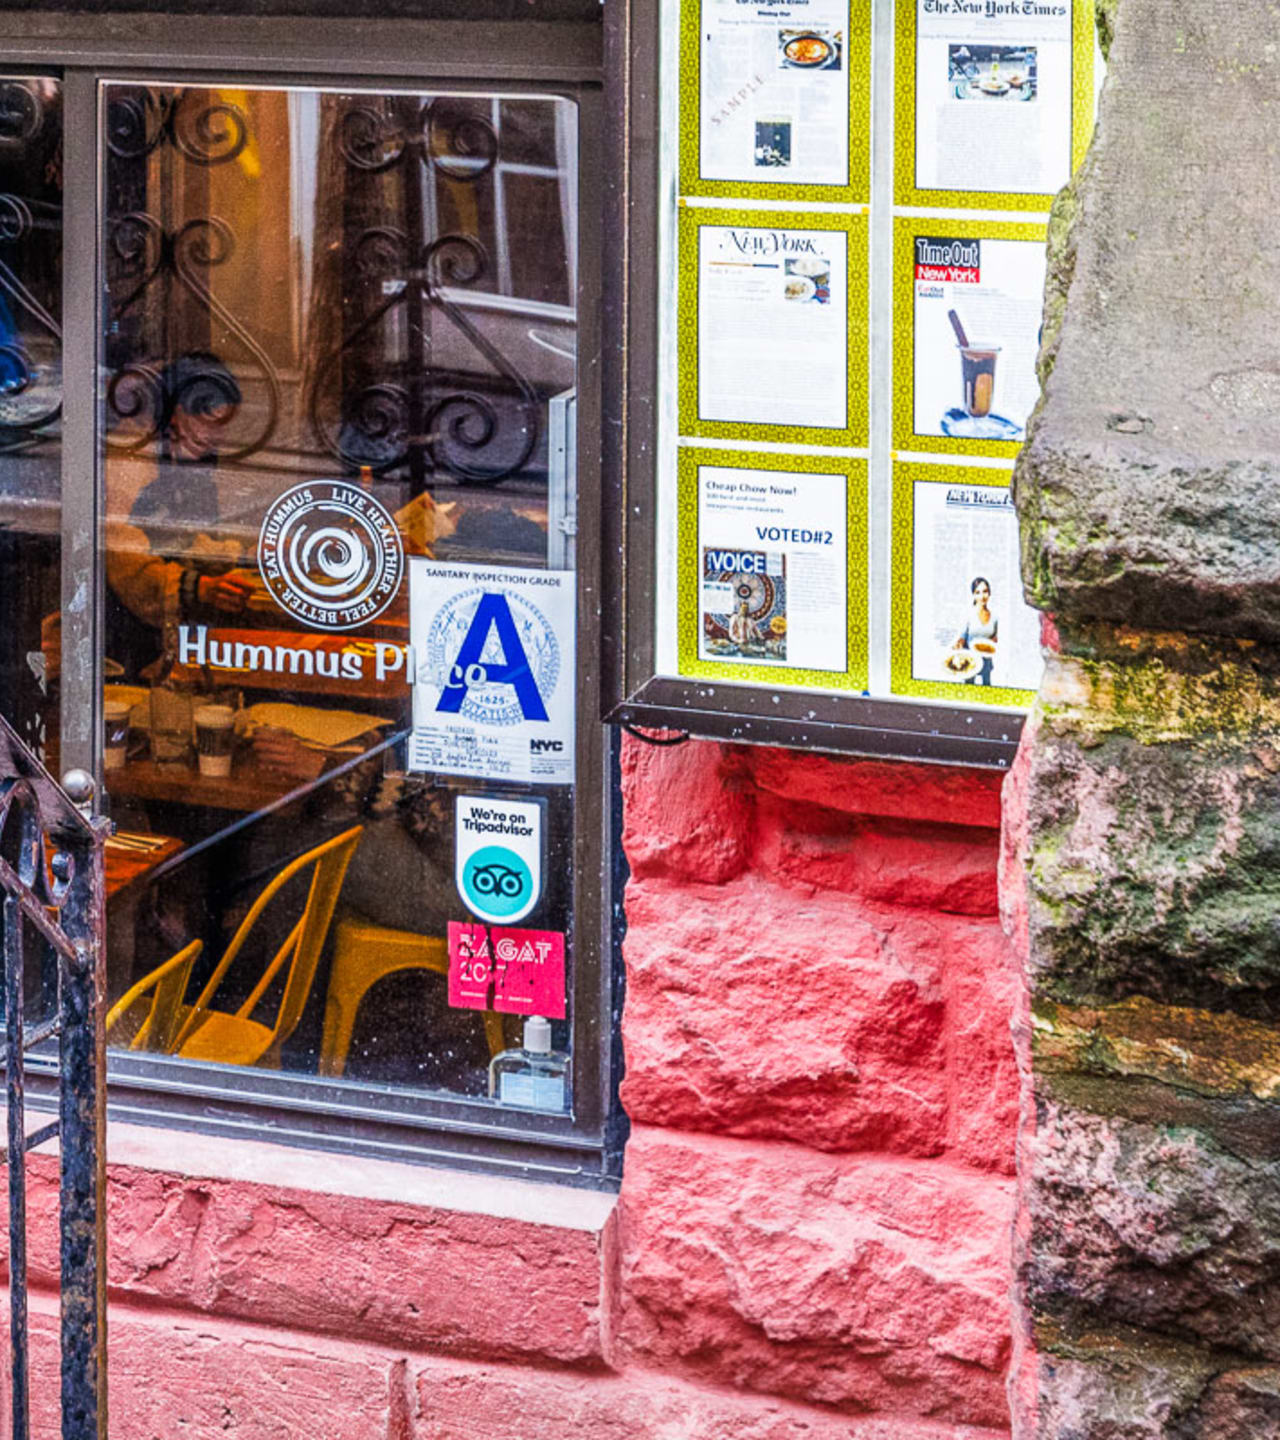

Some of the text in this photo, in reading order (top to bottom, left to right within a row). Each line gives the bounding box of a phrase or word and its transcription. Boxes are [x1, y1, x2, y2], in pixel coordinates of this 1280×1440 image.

[951, 0, 983, 13] New
[984, 0, 1020, 18] York
[1021, 0, 1067, 16] Times
[763, 232, 820, 256] YORK
[916, 238, 979, 268] Time Out
[918, 266, 977, 283] New York
[705, 481, 797, 496] Cheap Chow Now!
[263, 489, 314, 579] EAT HUMMUS
[332, 488, 398, 594] LIVE HEALTHIER
[756, 526, 833, 545] VOTED#2
[712, 551, 765, 573] VOICE
[426, 568, 561, 587] SANITARY INSPECTION GRADE
[282, 588, 377, 624] FEEL BETTER
[178, 625, 363, 680] Hummus
[435, 593, 550, 722] A
[530, 738, 564, 752] NYC
[470, 807, 527, 824] We're on
[462, 818, 534, 837] Tripadvisor
[460, 962, 507, 984] 207
